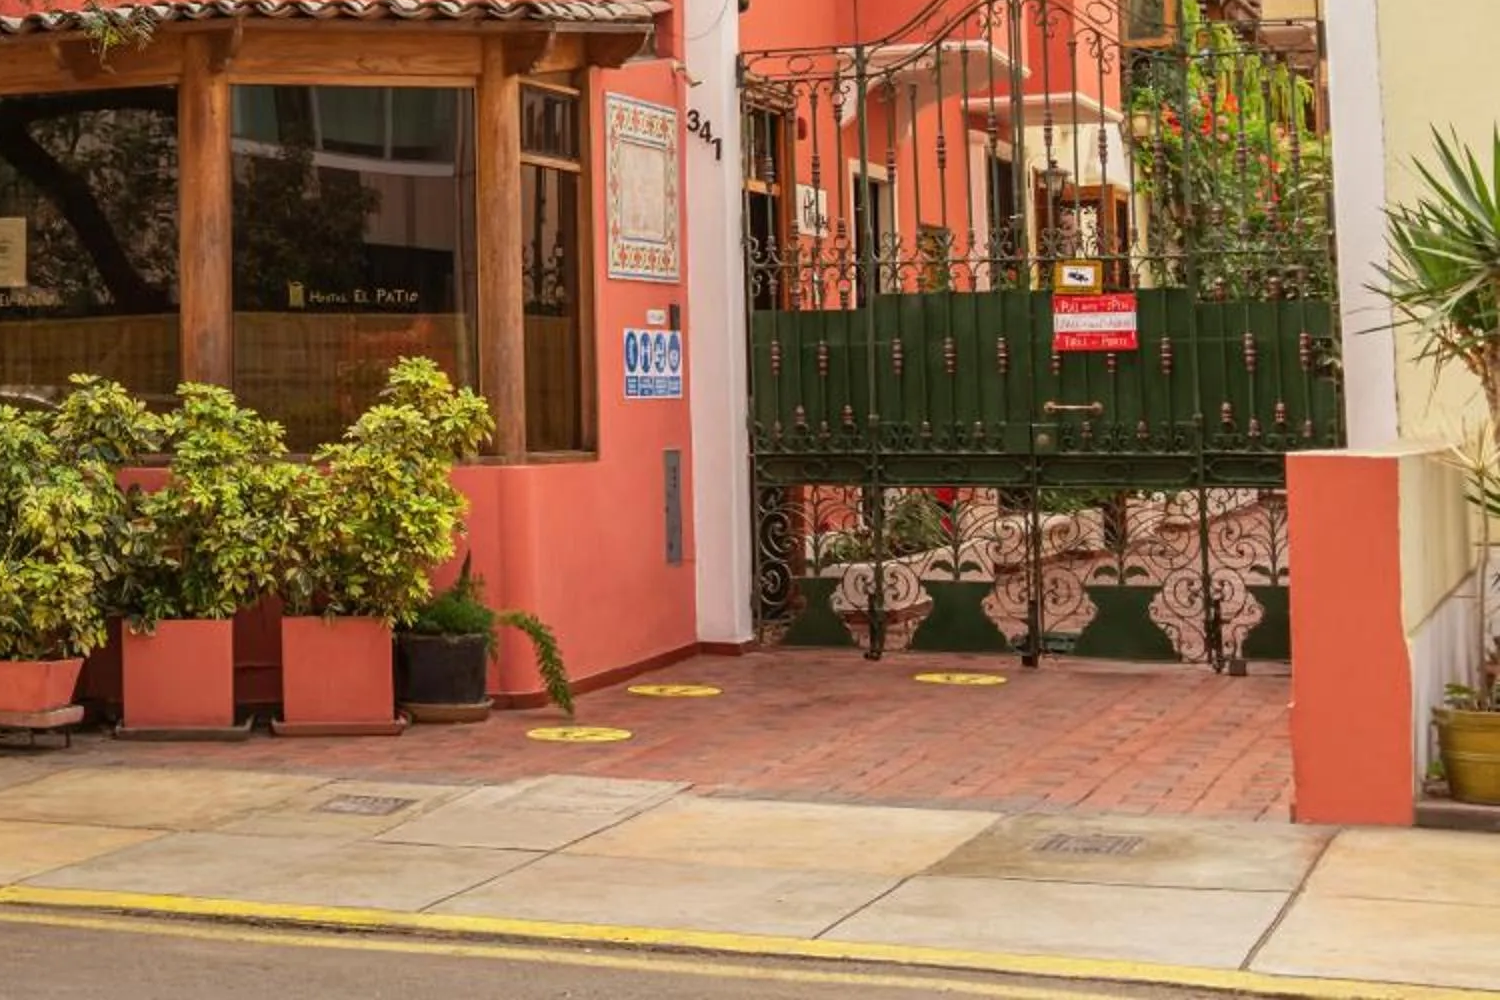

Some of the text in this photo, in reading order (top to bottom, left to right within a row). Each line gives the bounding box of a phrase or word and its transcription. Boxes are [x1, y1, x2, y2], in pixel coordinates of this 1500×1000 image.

[687, 109, 722, 161] 341
[354, 289, 369, 303] EL
[377, 287, 419, 304] PATIO
